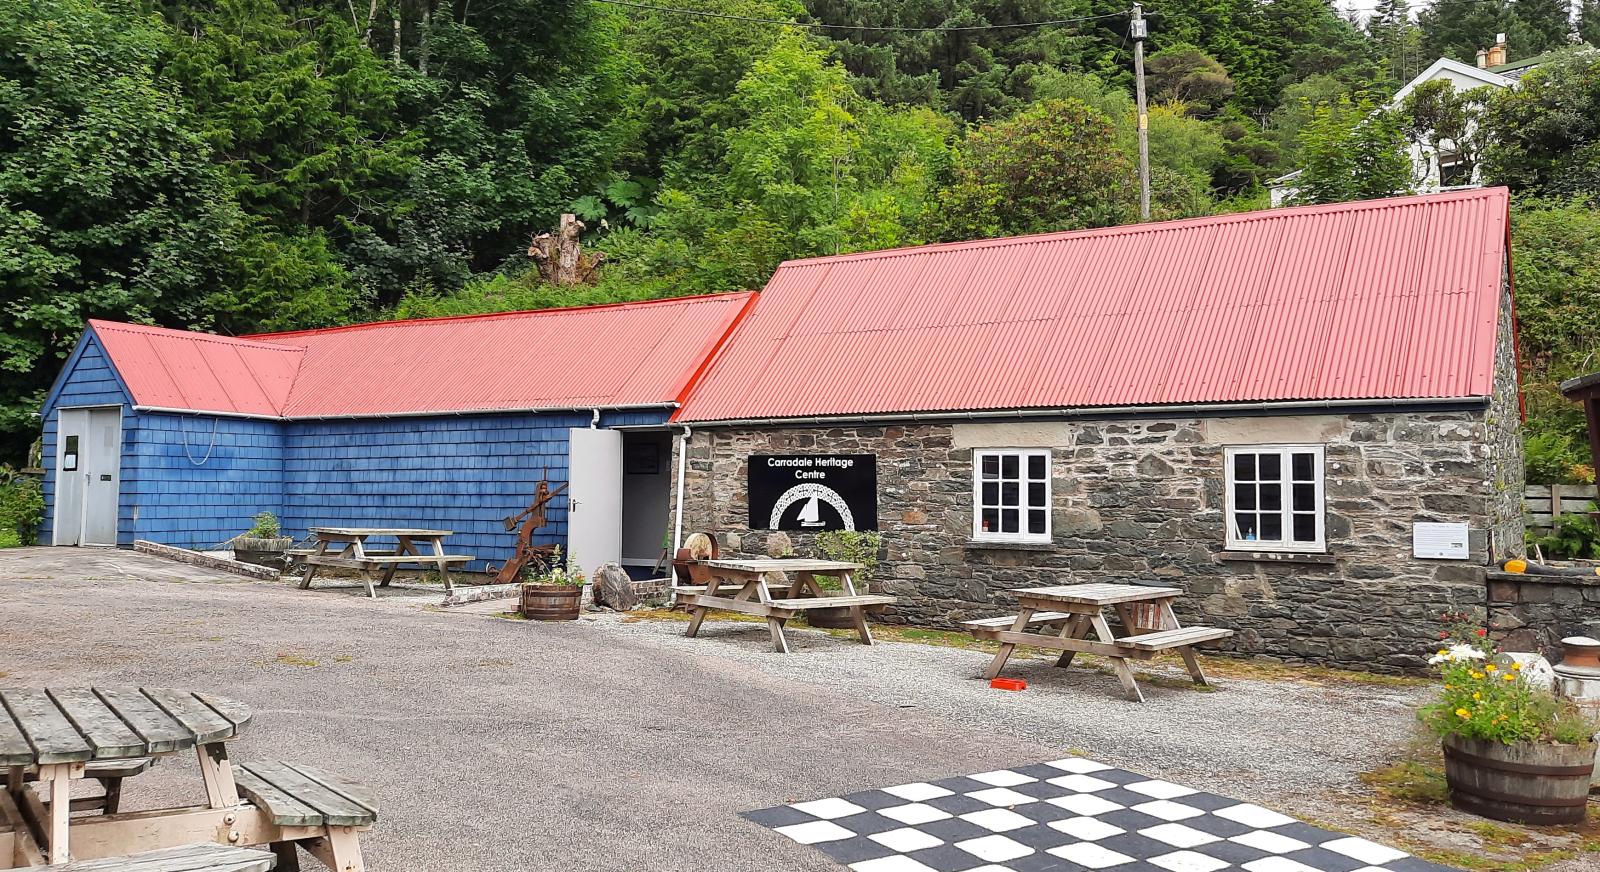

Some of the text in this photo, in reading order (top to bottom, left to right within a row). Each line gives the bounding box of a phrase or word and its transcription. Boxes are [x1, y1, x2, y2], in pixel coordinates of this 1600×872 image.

[767, 457, 853, 468] Carradale Heritage
[795, 470, 825, 479] Centre
